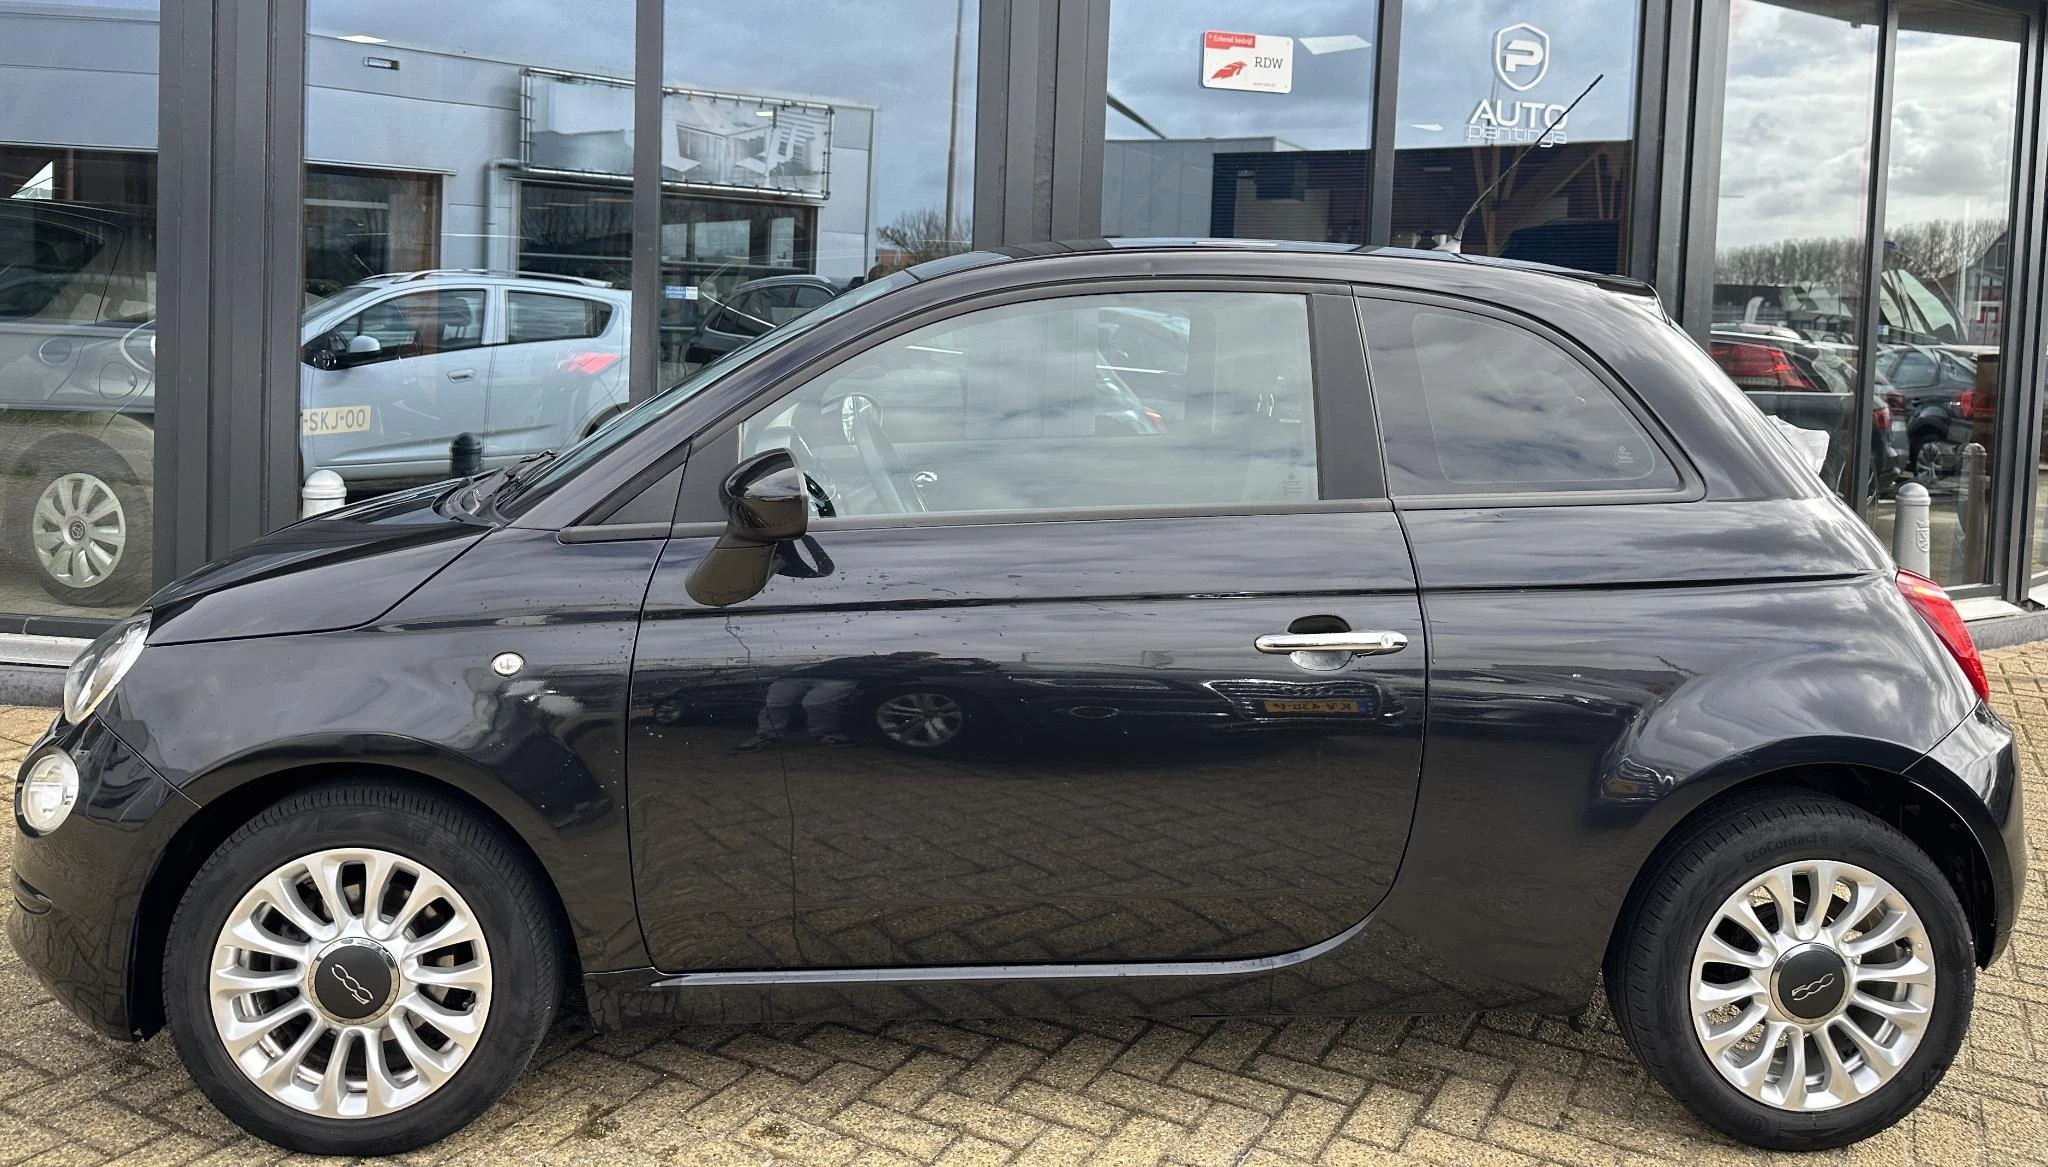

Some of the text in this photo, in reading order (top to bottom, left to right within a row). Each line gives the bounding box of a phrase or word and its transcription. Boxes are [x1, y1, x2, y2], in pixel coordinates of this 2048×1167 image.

[1254, 56, 1284, 70] RDW
[1470, 98, 1569, 130] AUTO
[1468, 123, 1568, 148] plantinga
[1743, 832, 1818, 863] EcoContact
